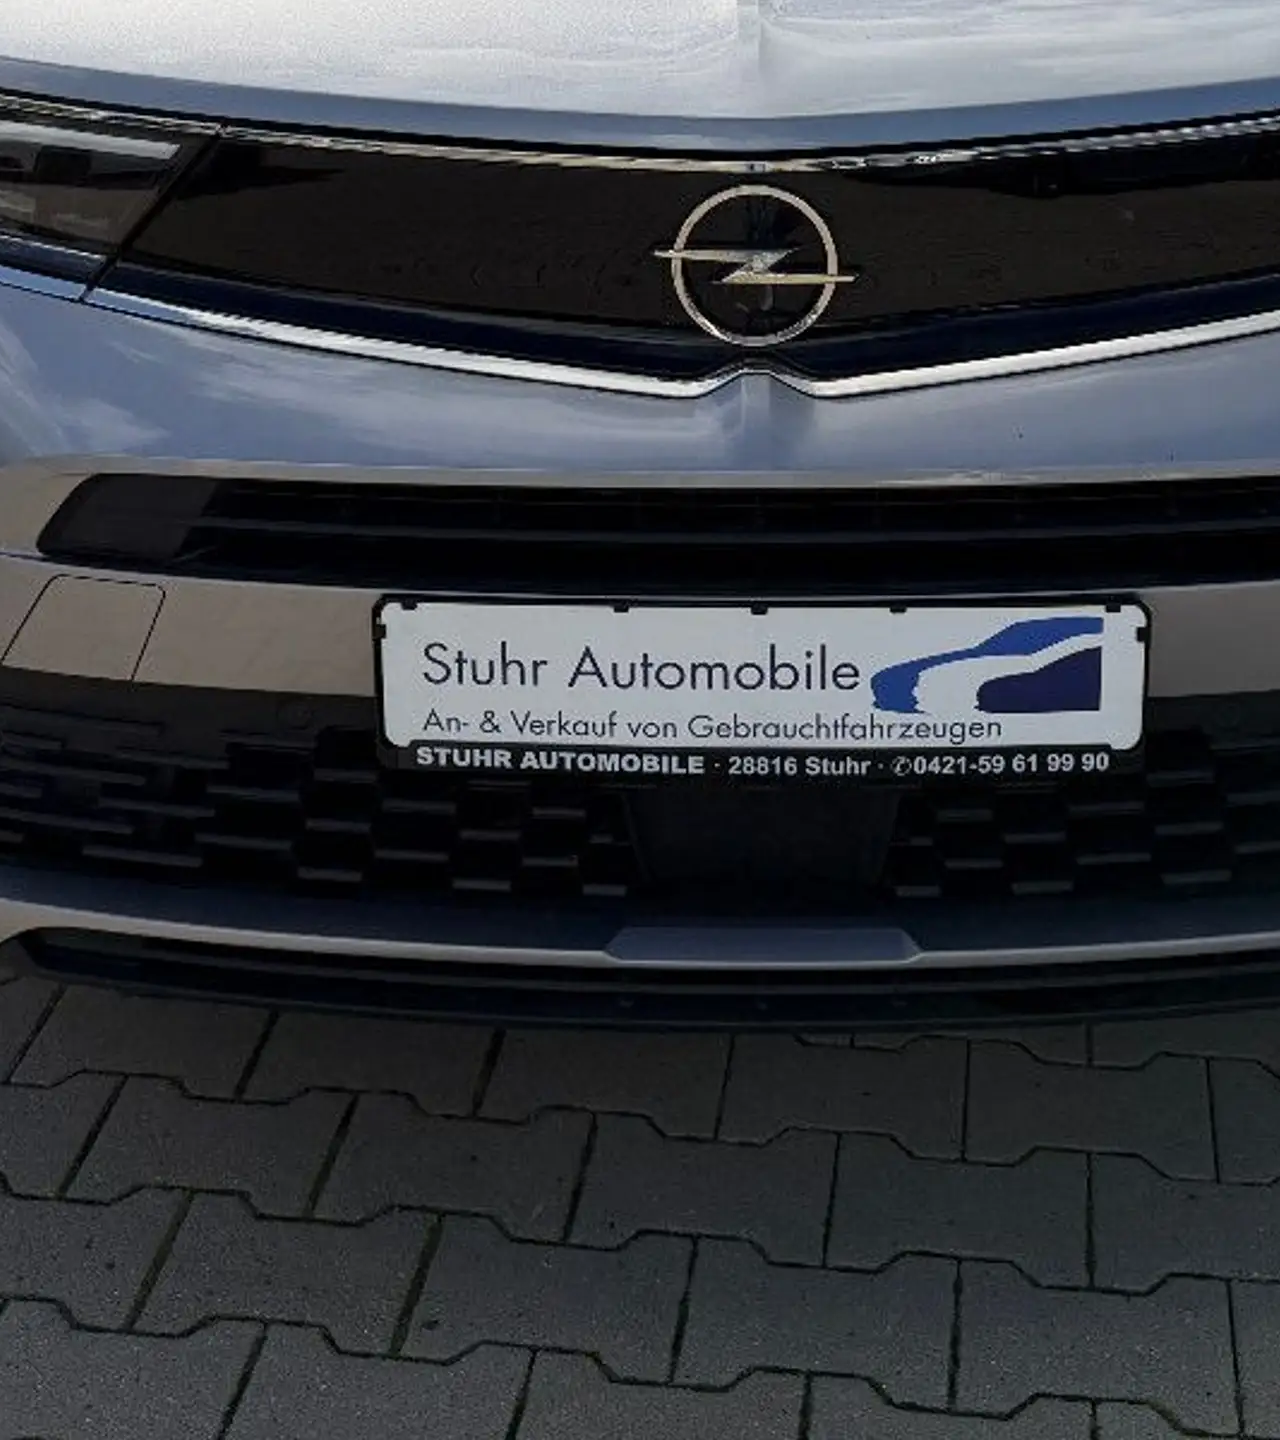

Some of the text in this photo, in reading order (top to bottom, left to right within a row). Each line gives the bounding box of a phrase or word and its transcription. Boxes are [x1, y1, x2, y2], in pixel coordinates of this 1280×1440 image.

[422, 640, 861, 691] Stuhr Automobile
[422, 708, 1002, 745] An- & Verkauf von Gebrauchtfahrzeugen
[416, 745, 514, 769] STUHR
[519, 748, 706, 775] AUTOMOBILE
[727, 755, 798, 776] 28816
[804, 755, 872, 776] Stuhr
[1011, 753, 1039, 774] 61
[1046, 752, 1075, 774] 99
[1080, 751, 1110, 774] 90
